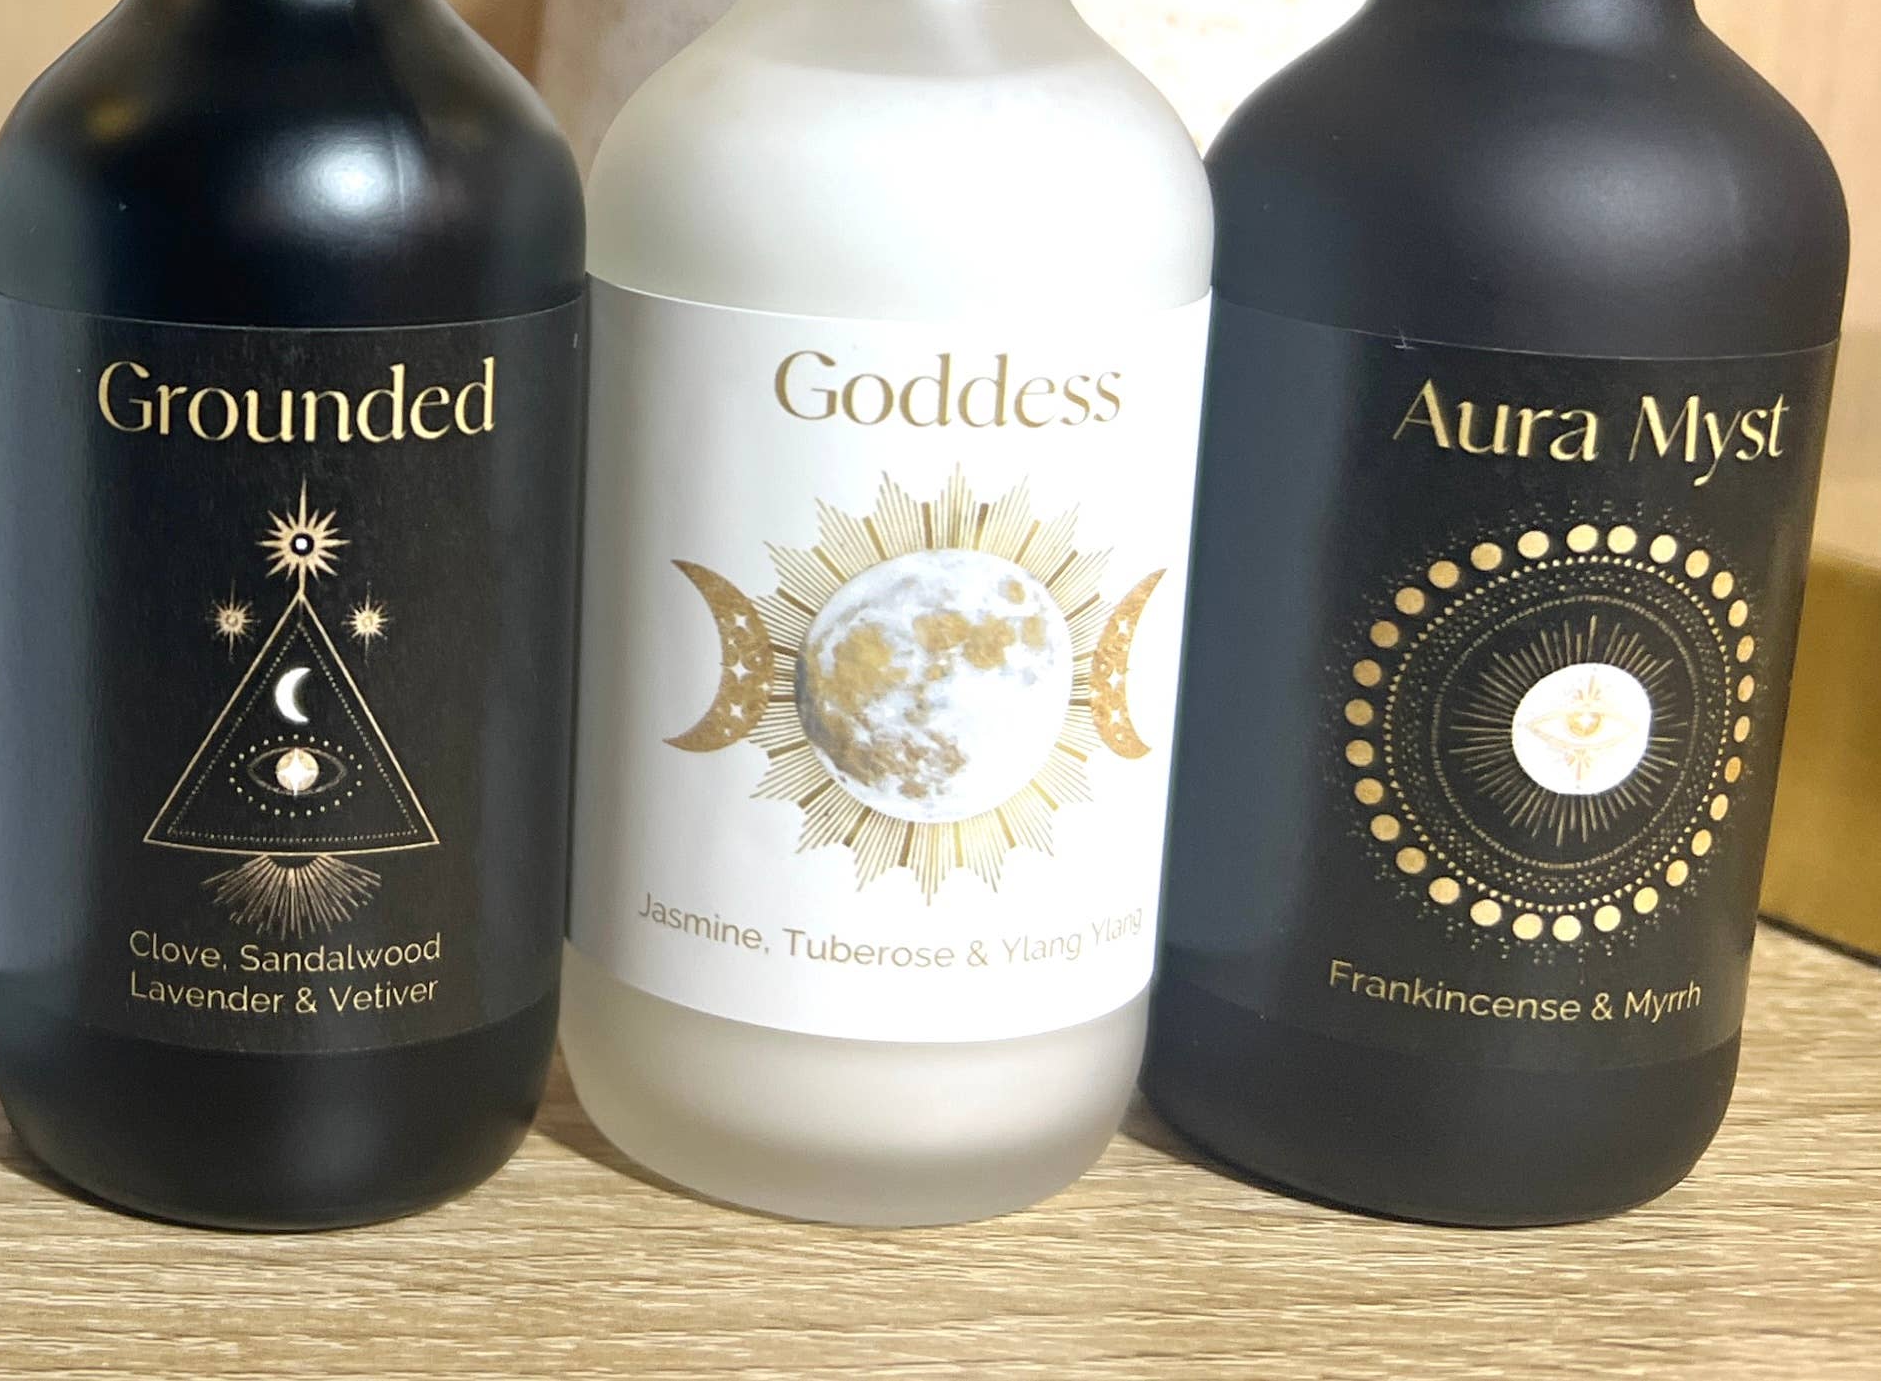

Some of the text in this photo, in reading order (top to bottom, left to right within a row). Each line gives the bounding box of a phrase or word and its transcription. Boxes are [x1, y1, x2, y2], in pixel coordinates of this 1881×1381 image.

[97, 357, 497, 443] Grounded
[774, 350, 1122, 428] Goddess
[1393, 379, 1790, 486] Aura Myst
[129, 931, 442, 973] Clove, Sandalwood
[637, 892, 1143, 969] Jasmine, Tuberose & Ylang Ylang
[131, 973, 439, 1014] Lavender & Vetiver
[1329, 959, 1702, 1023] Frankincense & Myrrh
